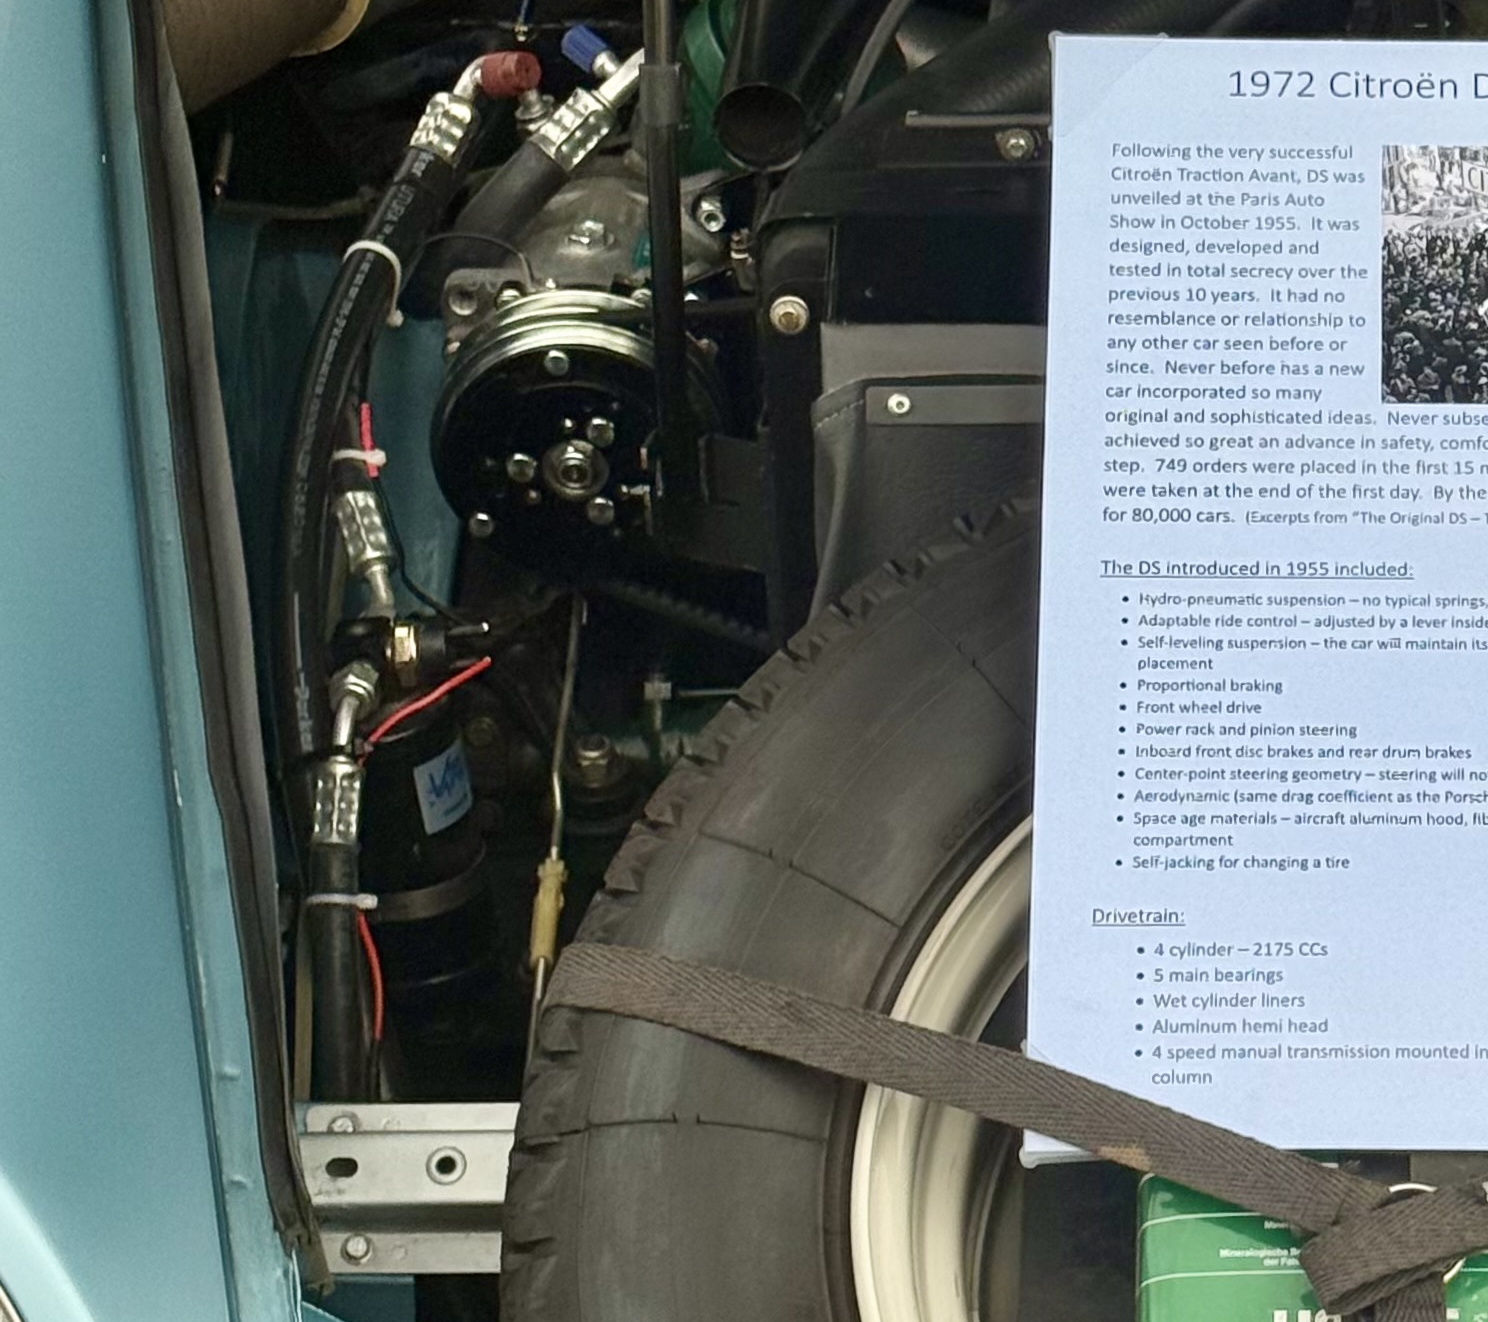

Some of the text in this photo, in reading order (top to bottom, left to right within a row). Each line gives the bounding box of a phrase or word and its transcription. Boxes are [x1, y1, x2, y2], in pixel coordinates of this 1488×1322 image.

[1229, 70, 1316, 98] 1972
[1329, 71, 1458, 99] Citroën
[1112, 142, 1353, 162] Following the very successful
[1111, 166, 1365, 185] Citroën Traction Avant, DS was
[1110, 190, 1325, 207] unveiled at the Paris Auto
[1109, 213, 1360, 231] Show in October 1955. It was
[1109, 237, 1320, 258] designed, developed and
[1109, 262, 1368, 281] tested in total secrecy over the
[1100, 559, 1414, 577] The DS introduced in 1955 included:
[1136, 700, 1262, 714] Front wheel drive
[1136, 743, 1472, 760] Inboard front disc brakes and rear drum brakes
[1134, 788, 1230, 805] Aerodynamic
[1281, 789, 1314, 805] drag
[1317, 789, 1393, 803] coefficient
[1396, 793, 1413, 803] as
[1416, 789, 1440, 803] the
[1092, 907, 1186, 925] Drivetrain:
[1154, 943, 1164, 957] 4
[1169, 941, 1234, 961] cylinder
[1253, 942, 1294, 957] 2175
[1298, 942, 1328, 957] CCs
[1153, 967, 1284, 985] 5 main bearings
[1152, 992, 1306, 1011] Wet cylinder liners
[1152, 1017, 1328, 1035] Aluminum hemi head
[1152, 1045, 1162, 1059] 4
[1166, 1043, 1216, 1063] speed
[1221, 1043, 1282, 1059] manual
[1287, 1044, 1390, 1059] transmission
[1395, 1043, 1470, 1059] mounted
[1474, 1044, 1488, 1059] in
[1151, 1069, 1212, 1085] column
